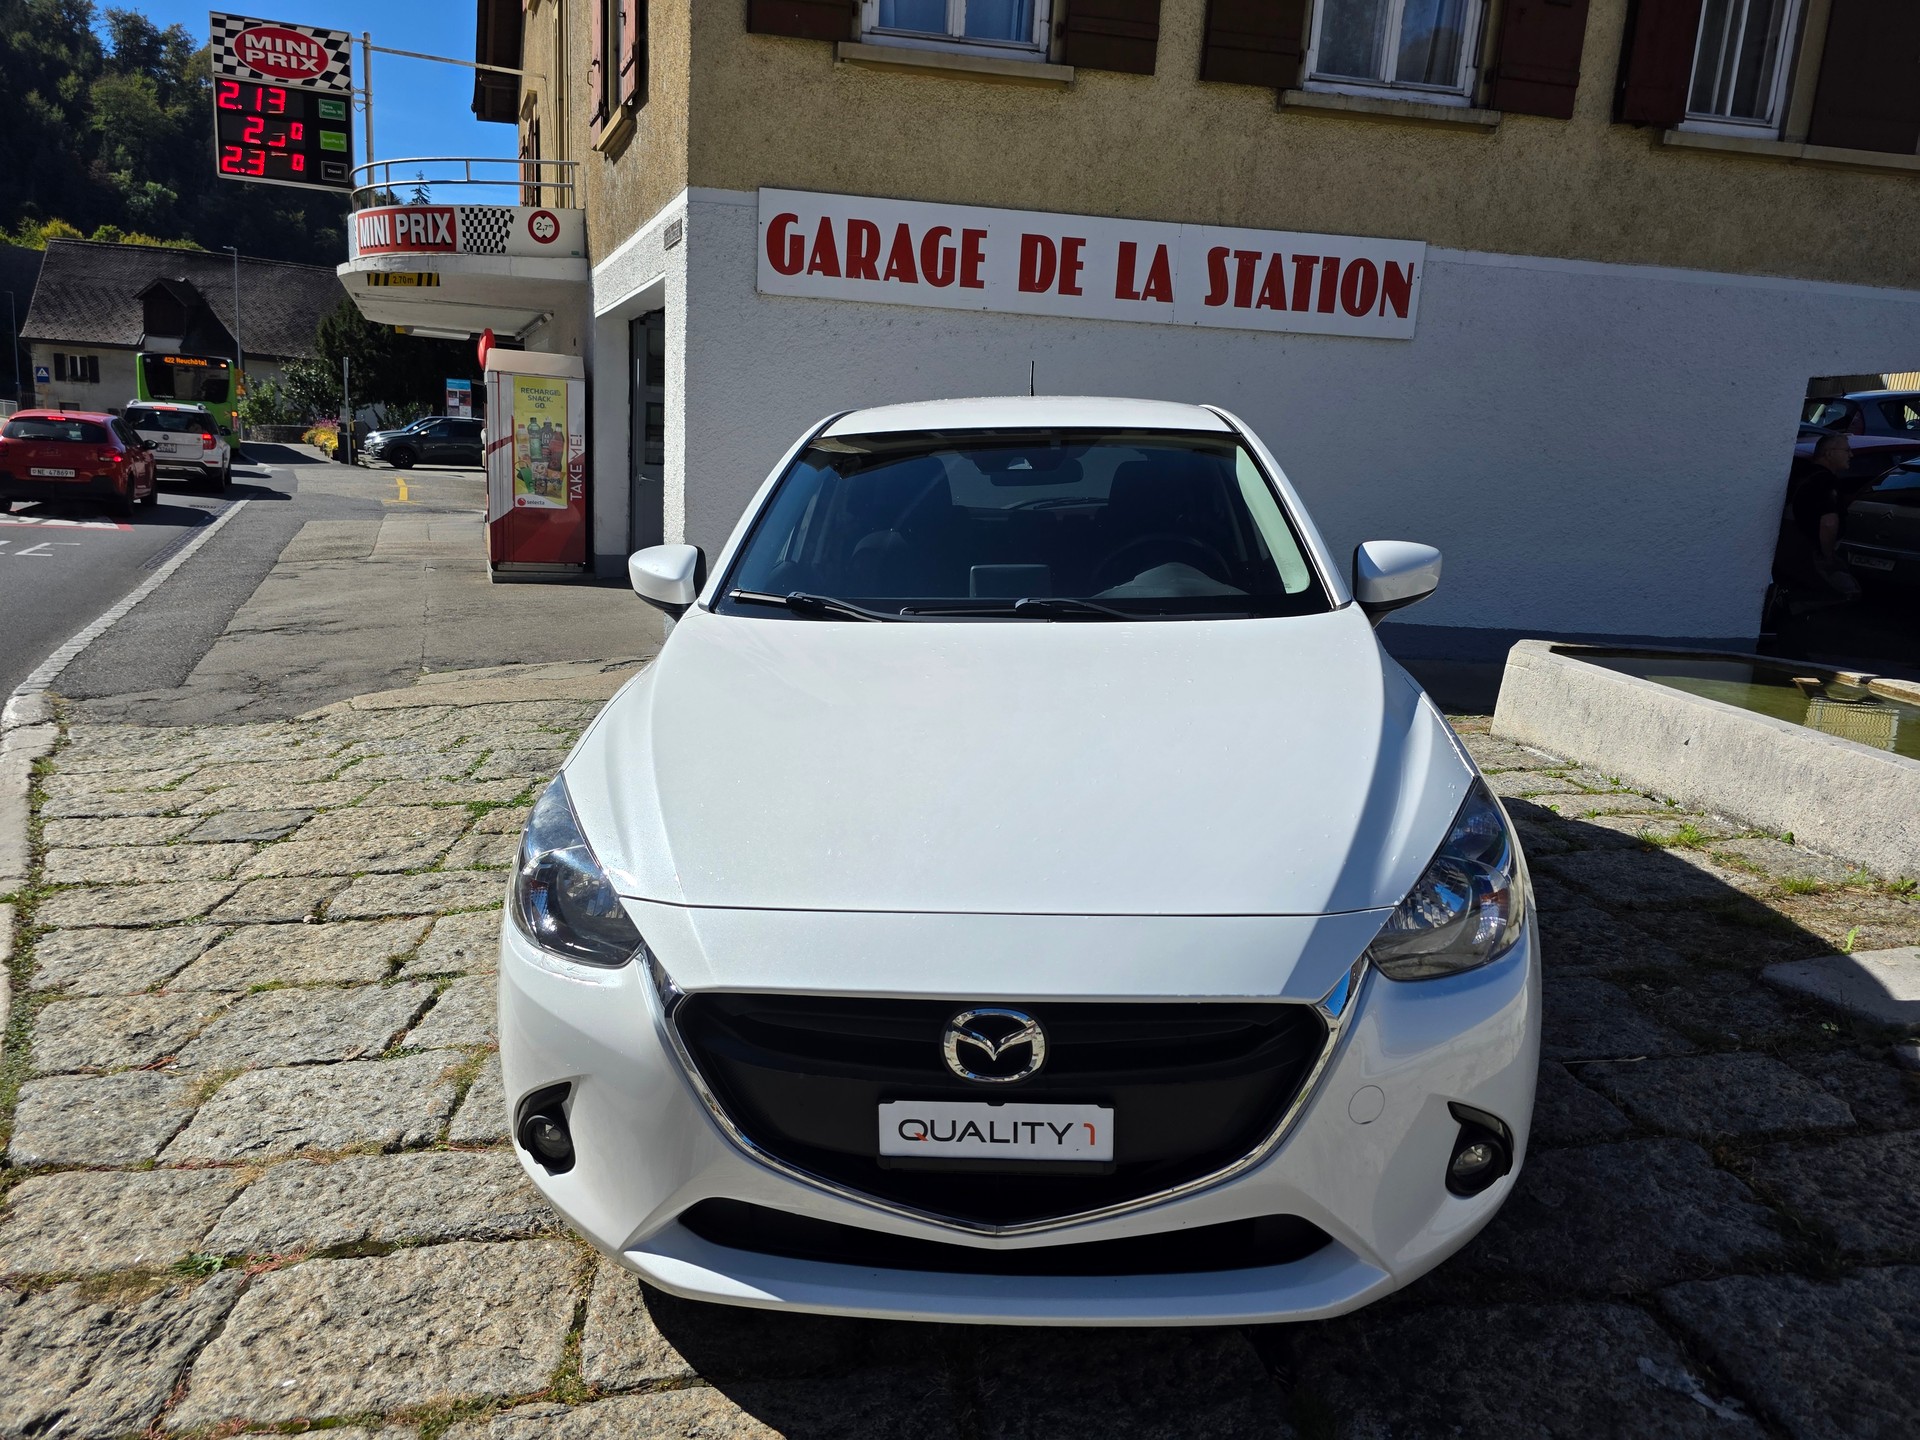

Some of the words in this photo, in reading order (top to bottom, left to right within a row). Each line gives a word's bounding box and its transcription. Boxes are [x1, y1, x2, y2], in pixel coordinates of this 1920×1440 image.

[244, 33, 319, 58] MINI
[245, 49, 321, 72] PRIX
[360, 214, 391, 250] MINI
[395, 212, 453, 244] PRIX
[766, 212, 988, 289] GARAGE
[1018, 233, 1087, 296] DE
[1115, 241, 1174, 303] LA
[1204, 246, 1415, 319] STATION
[570, 434, 583, 463] ME!
[570, 464, 583, 501] TAKE
[898, 1118, 1074, 1145] QUALITY
[1083, 1123, 1096, 1146] 1
